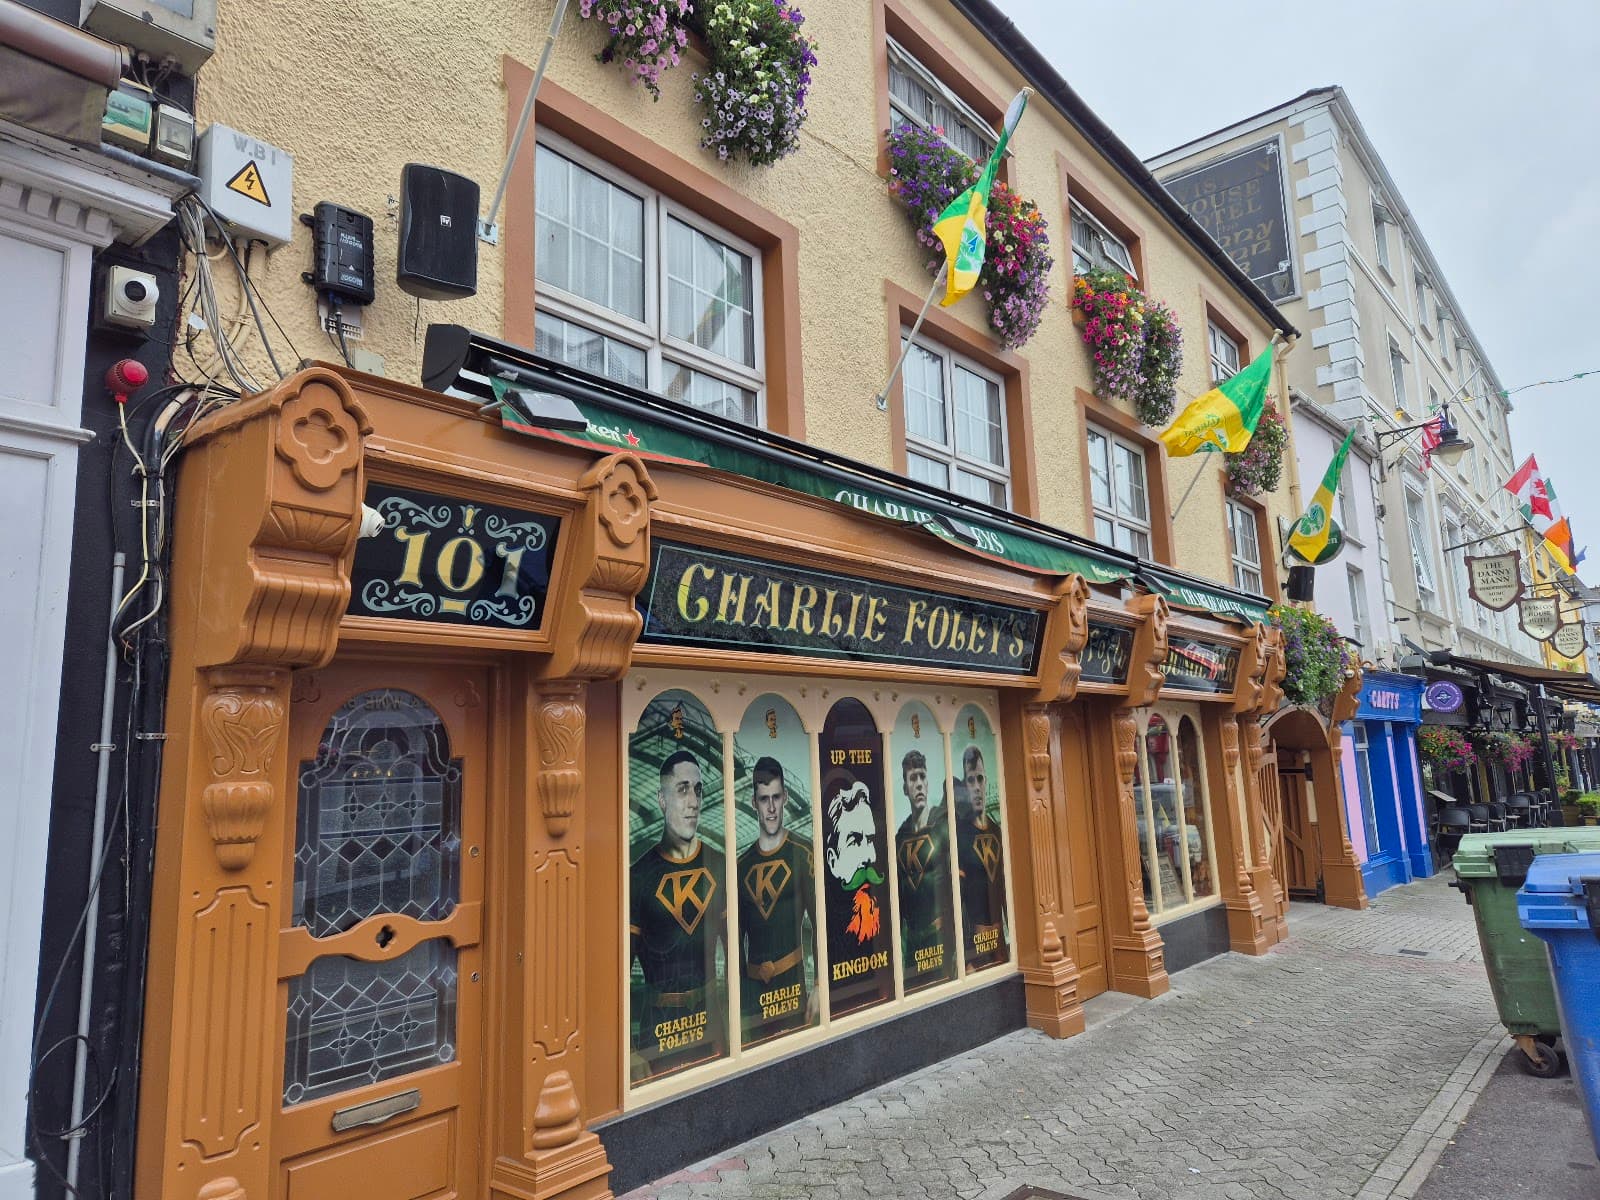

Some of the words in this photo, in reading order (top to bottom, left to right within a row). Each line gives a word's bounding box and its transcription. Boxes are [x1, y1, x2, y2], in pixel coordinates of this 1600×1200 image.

[392, 526, 529, 600] 101
[1478, 568, 1512, 577] DANNY
[676, 562, 890, 643] CHARLIE
[901, 599, 1029, 659] FOLEY'S
[830, 749, 846, 765] UP
[848, 749, 873, 764] THE
[973, 929, 999, 944] CHARLIE
[976, 939, 998, 955] FOLEYS
[914, 944, 944, 961] CHARLIE
[917, 955, 943, 972] FOLEYS
[832, 951, 889, 981] KINGDOM
[759, 983, 801, 1006] CHARLIE
[762, 997, 799, 1019] FOLEYS
[655, 1011, 707, 1038] CHARLIE
[659, 1027, 704, 1052] FOLEYS
